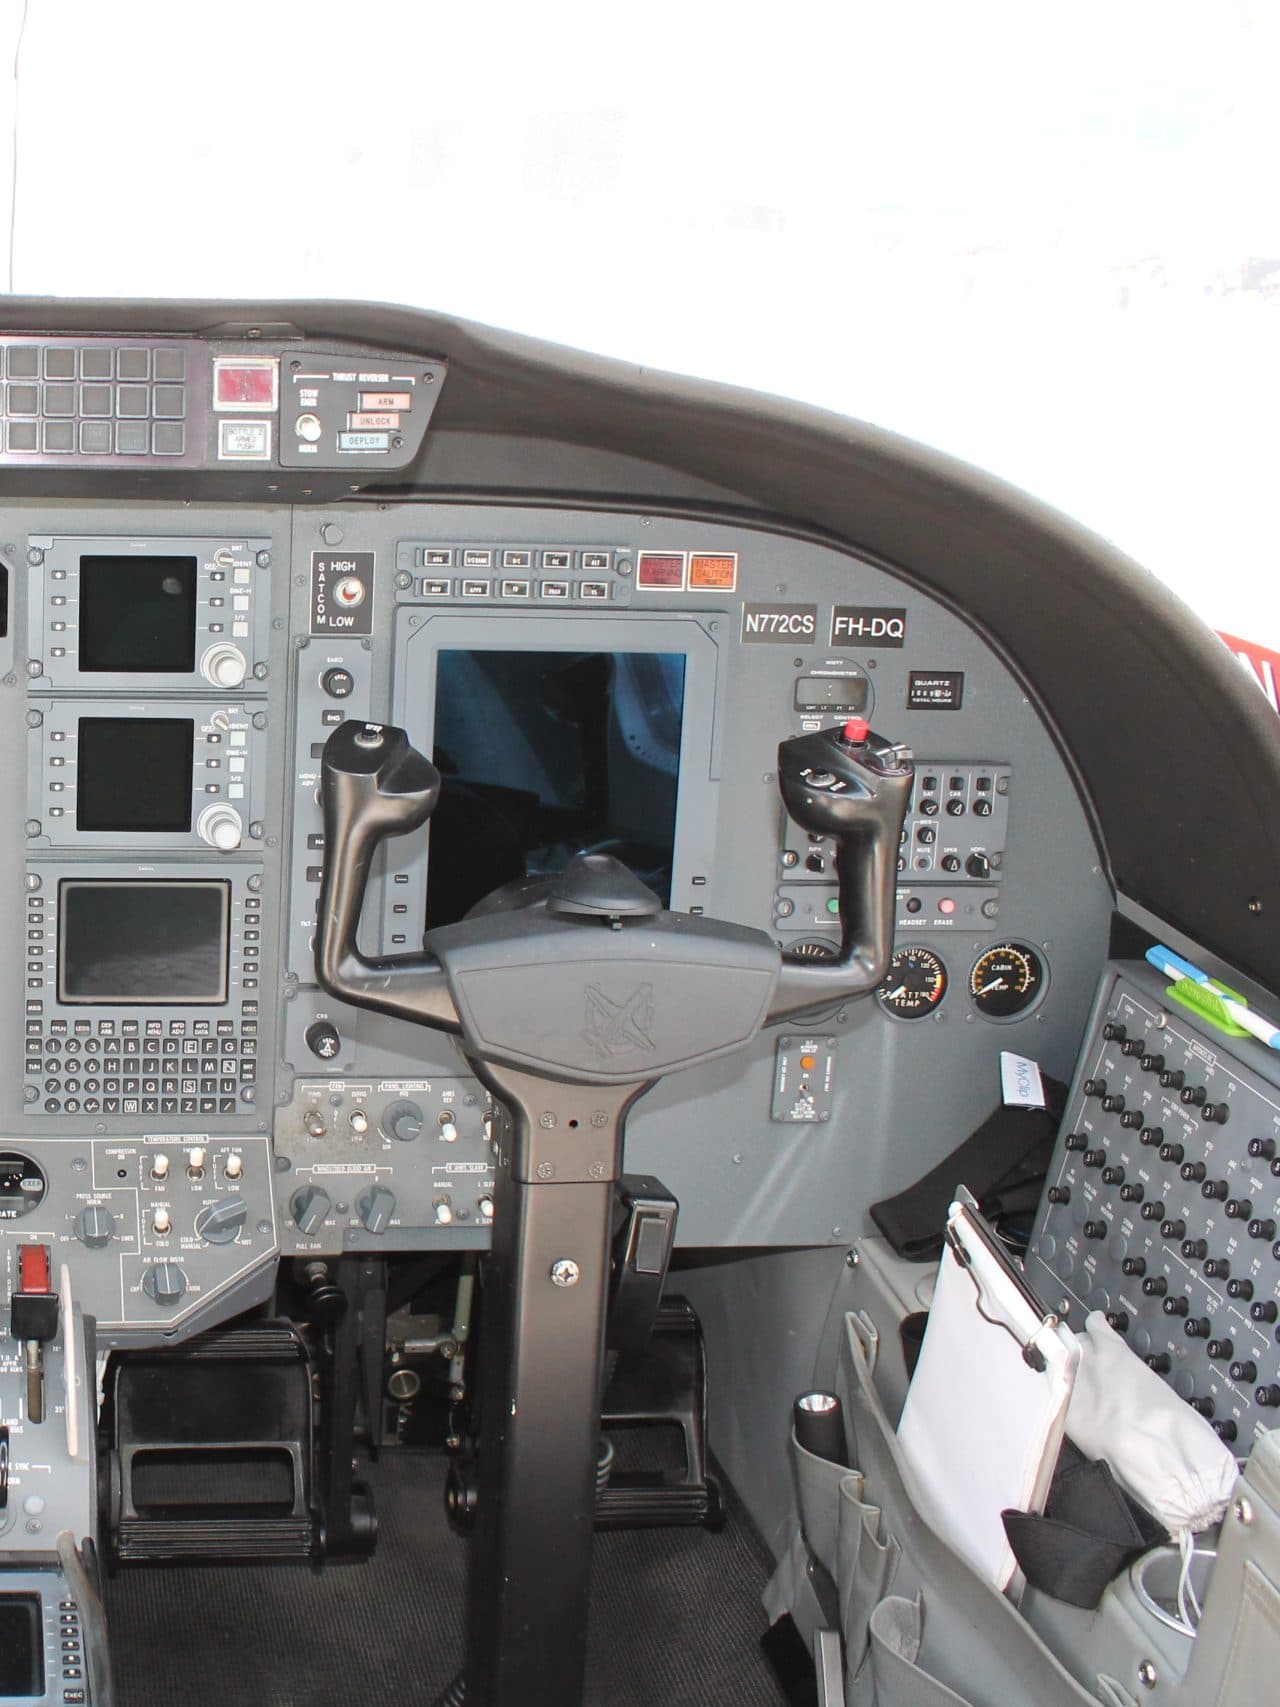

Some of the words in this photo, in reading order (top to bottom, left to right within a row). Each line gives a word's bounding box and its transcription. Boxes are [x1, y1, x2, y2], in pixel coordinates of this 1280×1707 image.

[360, 417, 390, 425] UNLOCK
[350, 436, 380, 445] DEPLOY
[331, 561, 356, 571] HIGH
[317, 562, 326, 624] SATCOM
[329, 617, 354, 627] LOW
[746, 614, 814, 633] N772CS
[834, 617, 904, 639] FH-DQ
[52, 1043, 55, 1051] 1
[69, 1042, 76, 1052] 2
[90, 1043, 96, 1051] 3
[108, 1043, 117, 1051] A
[128, 1042, 135, 1051] B
[148, 1043, 155, 1051] C
[167, 1043, 175, 1051] D
[188, 1043, 193, 1051] E
[207, 1043, 213, 1051] F
[225, 1043, 234, 1051] G
[49, 1063, 56, 1071] 4
[69, 1062, 76, 1071] 5
[89, 1063, 95, 1071] 6
[108, 1062, 116, 1071] H
[149, 1063, 154, 1071] J
[167, 1062, 174, 1071] K
[187, 1063, 192, 1071] L
[205, 1063, 214, 1071] M
[225, 1063, 233, 1071] N
[49, 1082, 56, 1091] 7
[69, 1083, 76, 1091] 8
[89, 1083, 95, 1091] 9
[107, 1082, 116, 1091] O
[128, 1082, 134, 1091] P
[146, 1082, 155, 1091] Q
[167, 1083, 173, 1091] R
[186, 1082, 193, 1091] S
[206, 1082, 212, 1091] T
[224, 1082, 232, 1091] U
[107, 1102, 115, 1111] V
[126, 1103, 136, 1111] W
[147, 1102, 154, 1111] X
[166, 1102, 173, 1111] Y
[185, 1102, 192, 1111] Z
